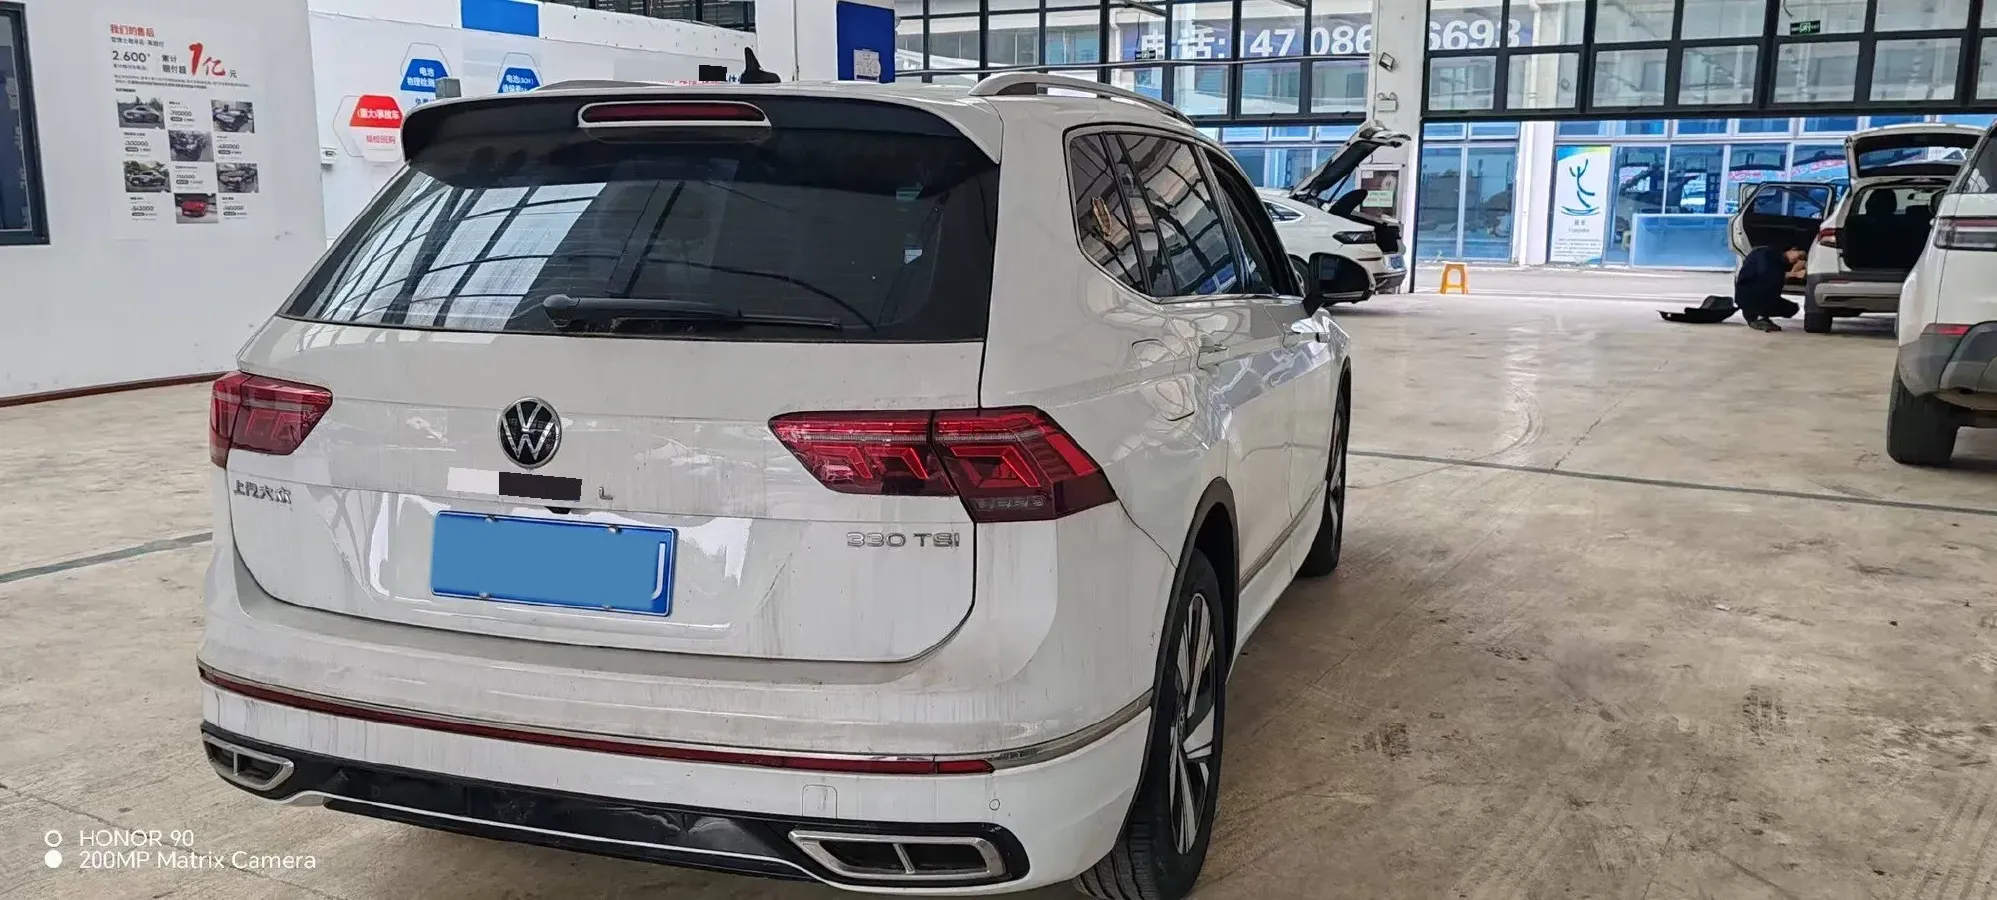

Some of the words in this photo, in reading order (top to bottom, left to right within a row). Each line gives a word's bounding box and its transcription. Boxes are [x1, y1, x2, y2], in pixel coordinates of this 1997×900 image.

[110, 23, 155, 37] 我们的售后
[419, 66, 435, 77] 电池
[233, 479, 292, 504] 上汽大众
[847, 531, 906, 548] 330
[913, 532, 960, 548] TSI
